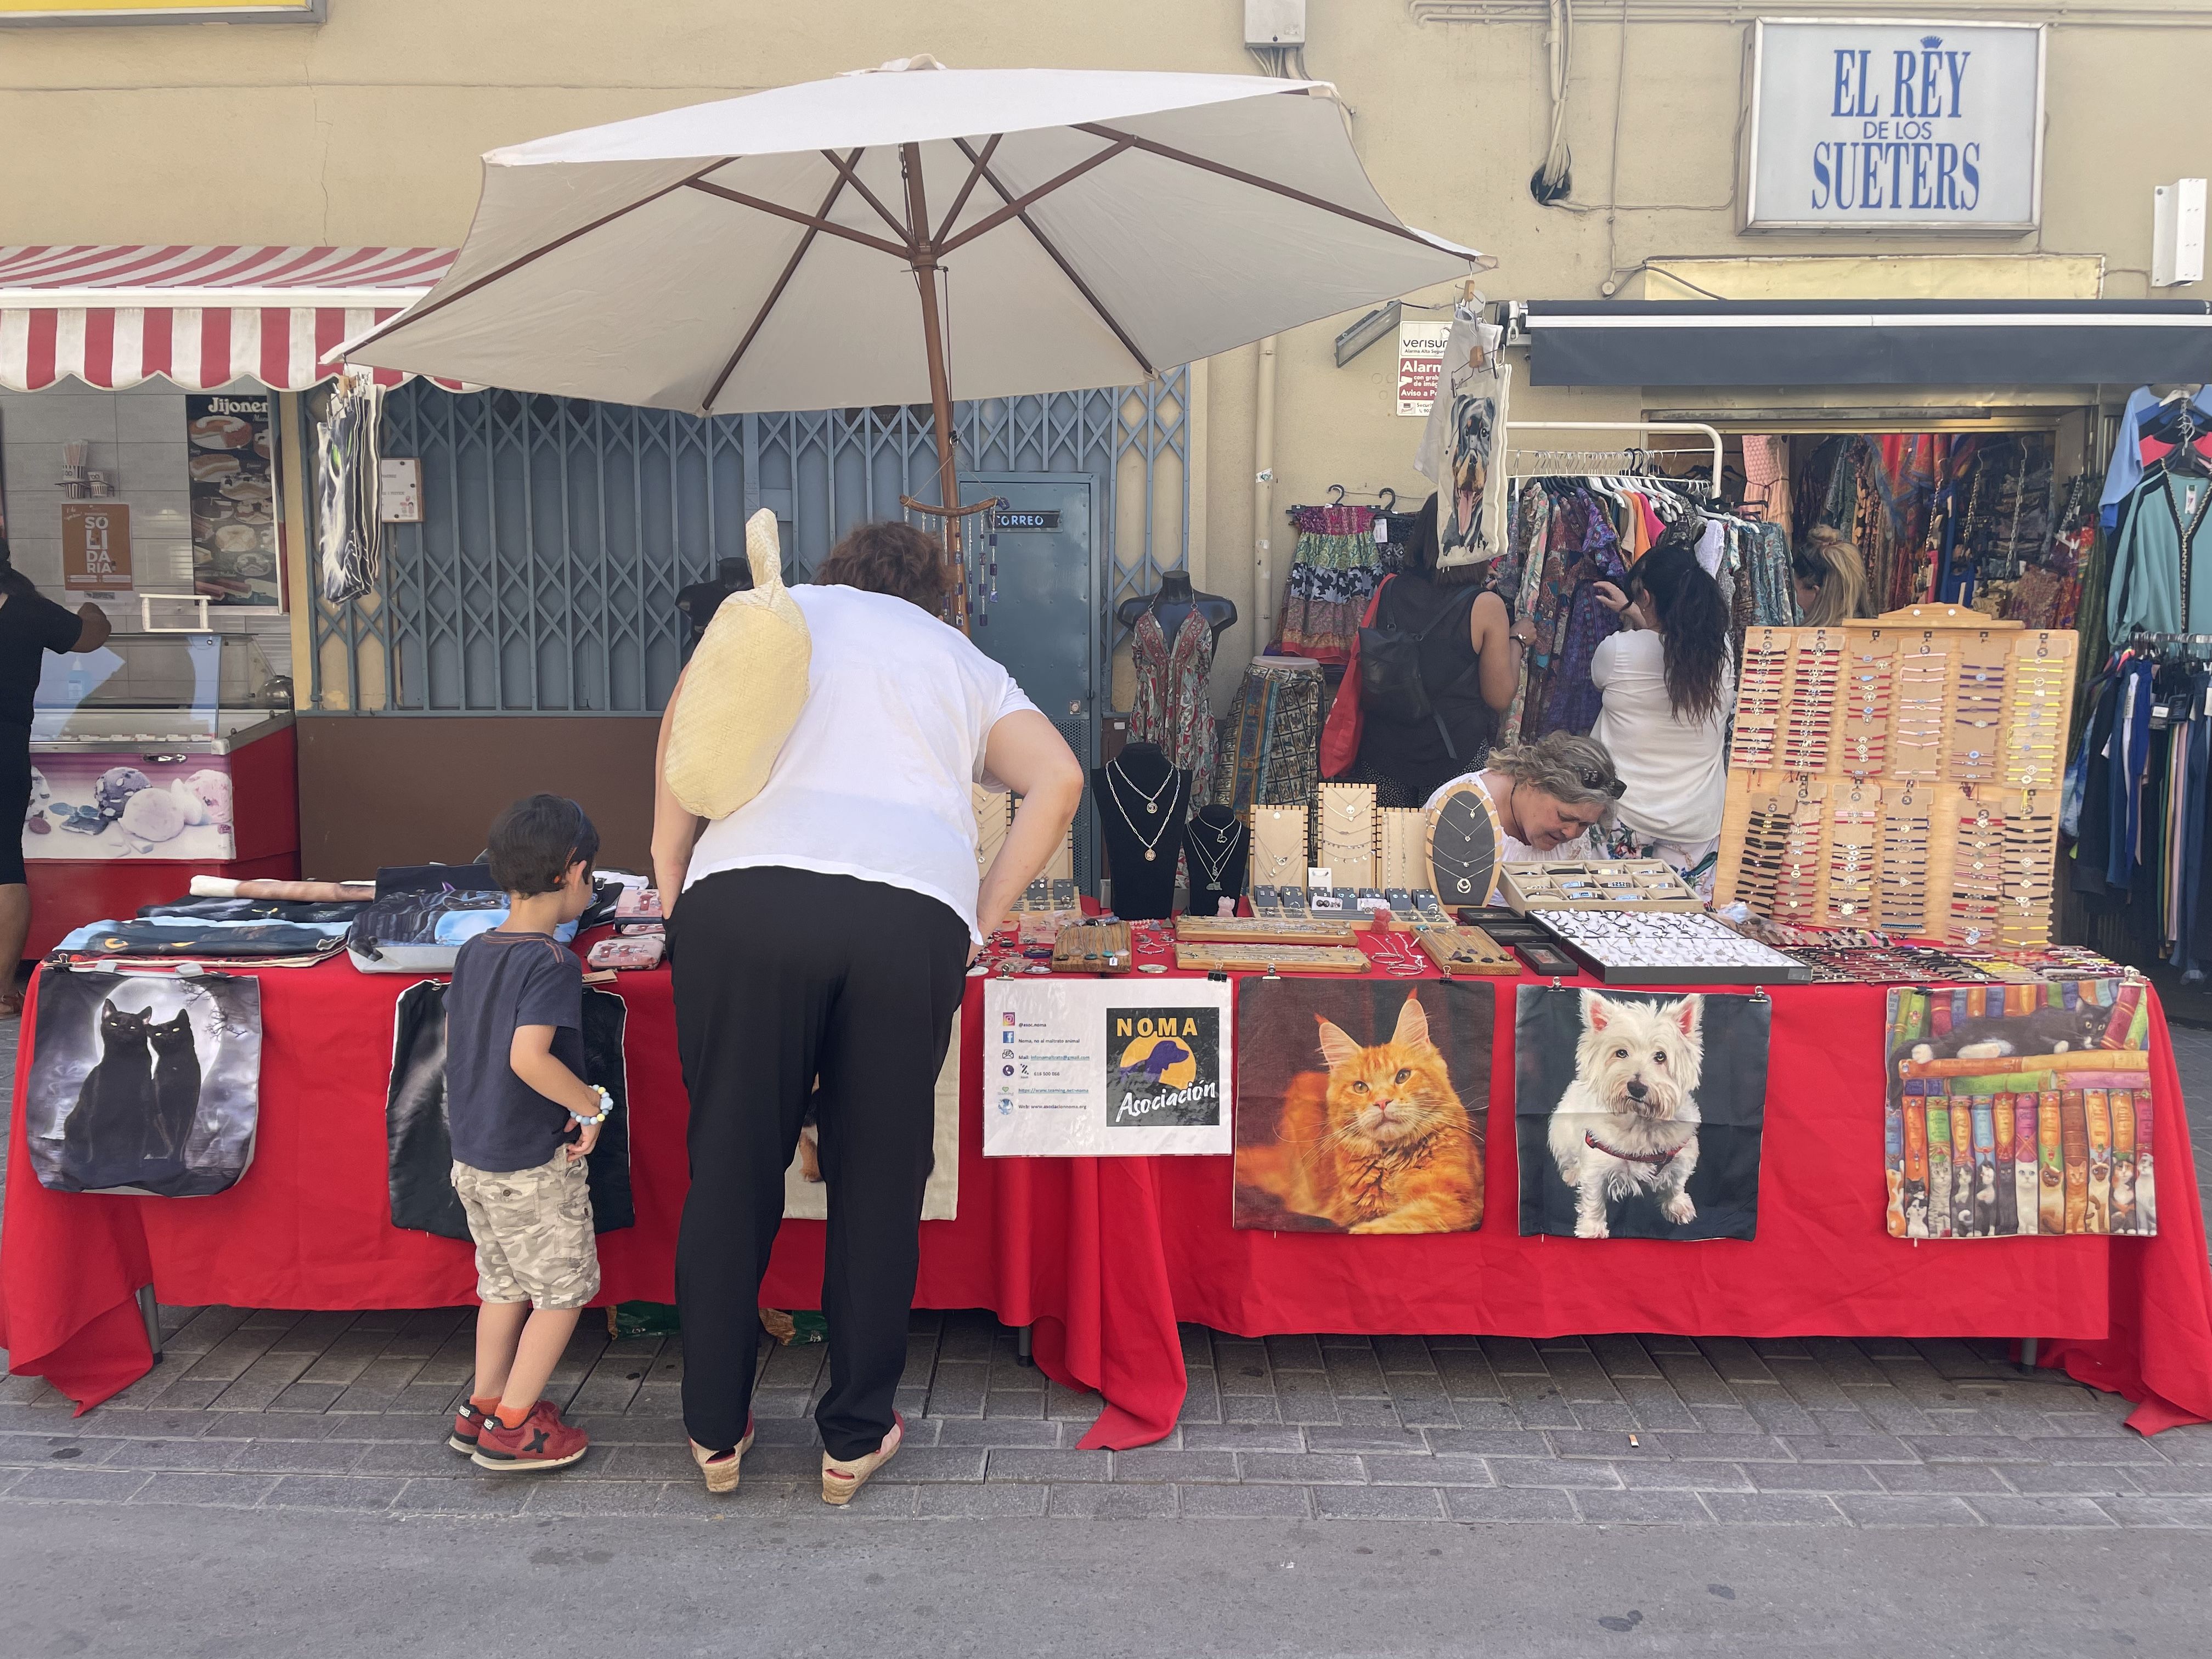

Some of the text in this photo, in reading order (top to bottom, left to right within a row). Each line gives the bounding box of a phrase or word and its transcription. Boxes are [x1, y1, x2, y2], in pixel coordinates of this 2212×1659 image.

[1831, 49, 1971, 119] EL REY
[1864, 121, 1932, 140] DE LOS
[1812, 141, 1979, 211] SUETERS
[84, 516, 109, 529] SO
[86, 529, 108, 550] LI
[86, 550, 111, 562] DA
[87, 562, 112, 573] RIA
[1117, 1018, 1198, 1036] NOMA
[1115, 1080, 1216, 1122] Asociación
